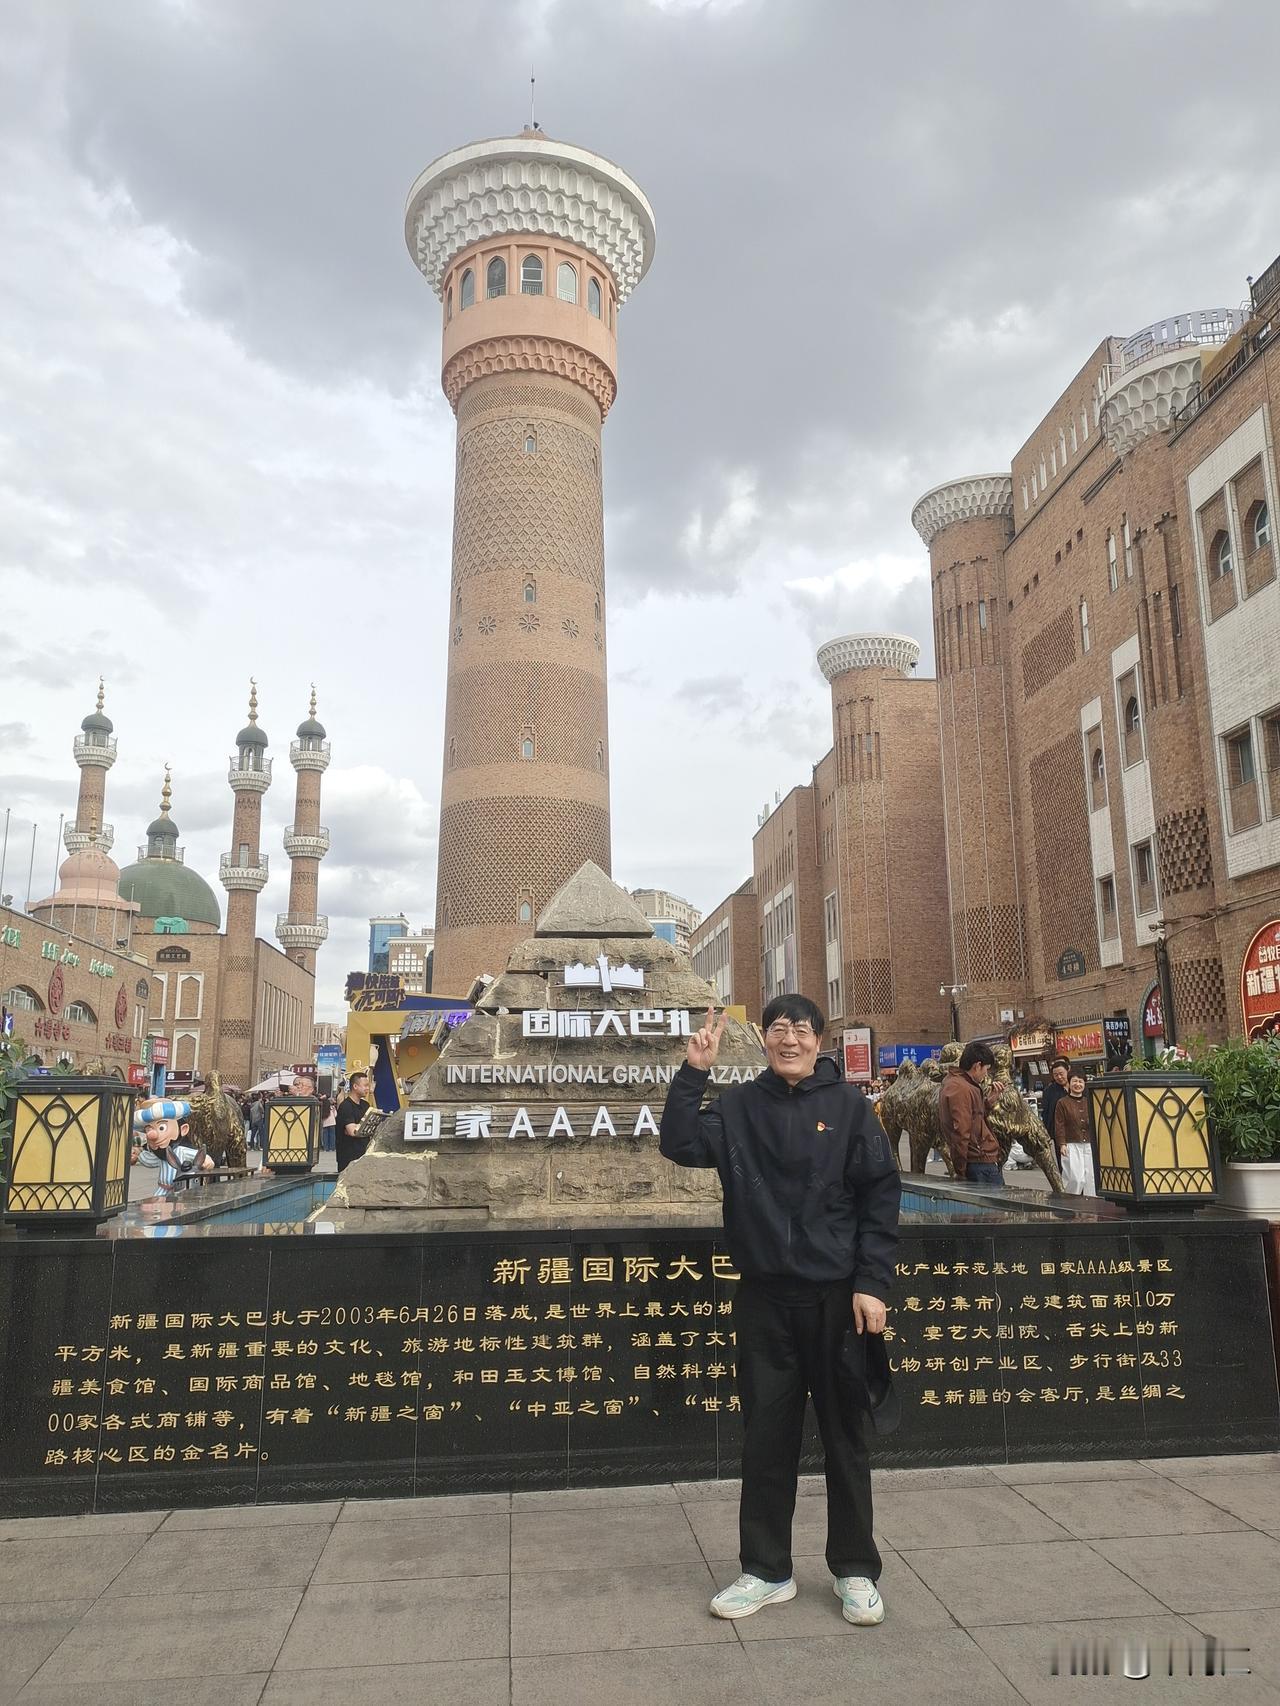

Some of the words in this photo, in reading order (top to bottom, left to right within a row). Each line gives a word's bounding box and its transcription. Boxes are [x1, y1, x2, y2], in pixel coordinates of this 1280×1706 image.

[522, 1009, 696, 1039] 国际大巴扎
[447, 1064, 609, 1085] INTERNATIONAL
[707, 1065, 767, 1084] AZAA
[493, 1254, 742, 1285] 新疆国际大巴
[894, 1261, 1029, 1276] 化产业示范基地
[1040, 1258, 1173, 1275] 国家AAAA级景区
[885, 1290, 1176, 1313] ,意为集市),总建筑面积10万
[51, 1362, 737, 1396] 疆美食馆、国际商品馆、地毯馆，和田玉文博馆、自然科学
[43, 1442, 270, 1466] 路核心区的金名片。
